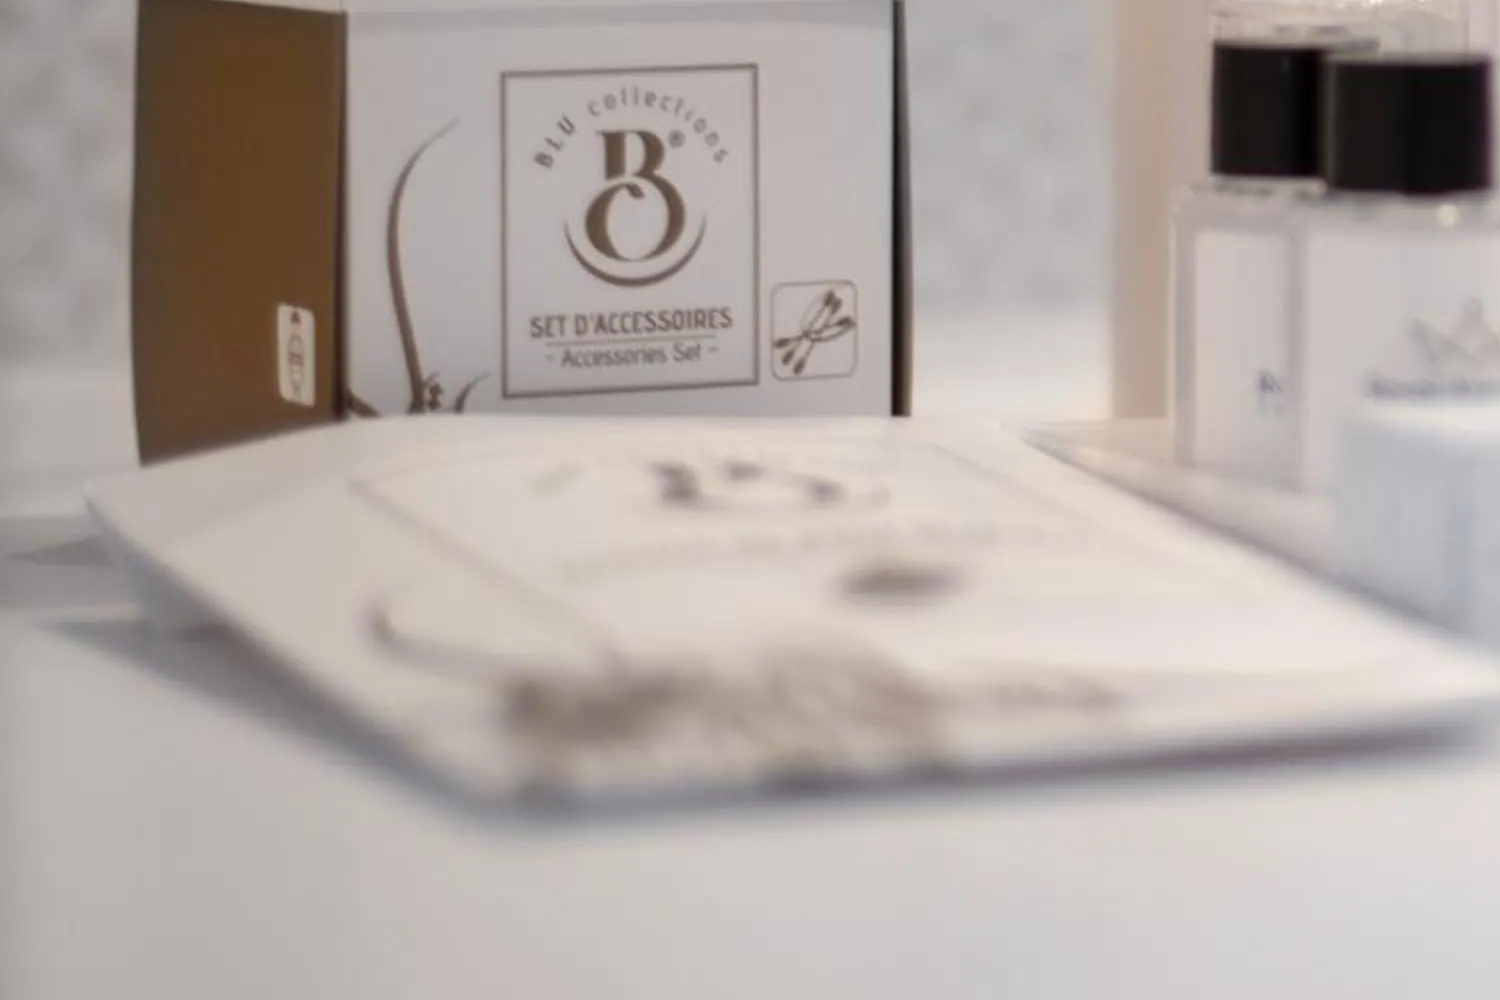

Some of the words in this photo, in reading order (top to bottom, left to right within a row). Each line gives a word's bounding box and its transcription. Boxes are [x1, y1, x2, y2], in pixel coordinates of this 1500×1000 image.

[533, 112, 577, 170] BLU
[587, 85, 728, 164] collections
[529, 314, 567, 339] SET
[575, 306, 734, 337] D'ACCESSOIRES
[561, 346, 668, 369] Accessories
[672, 341, 702, 363] Set
